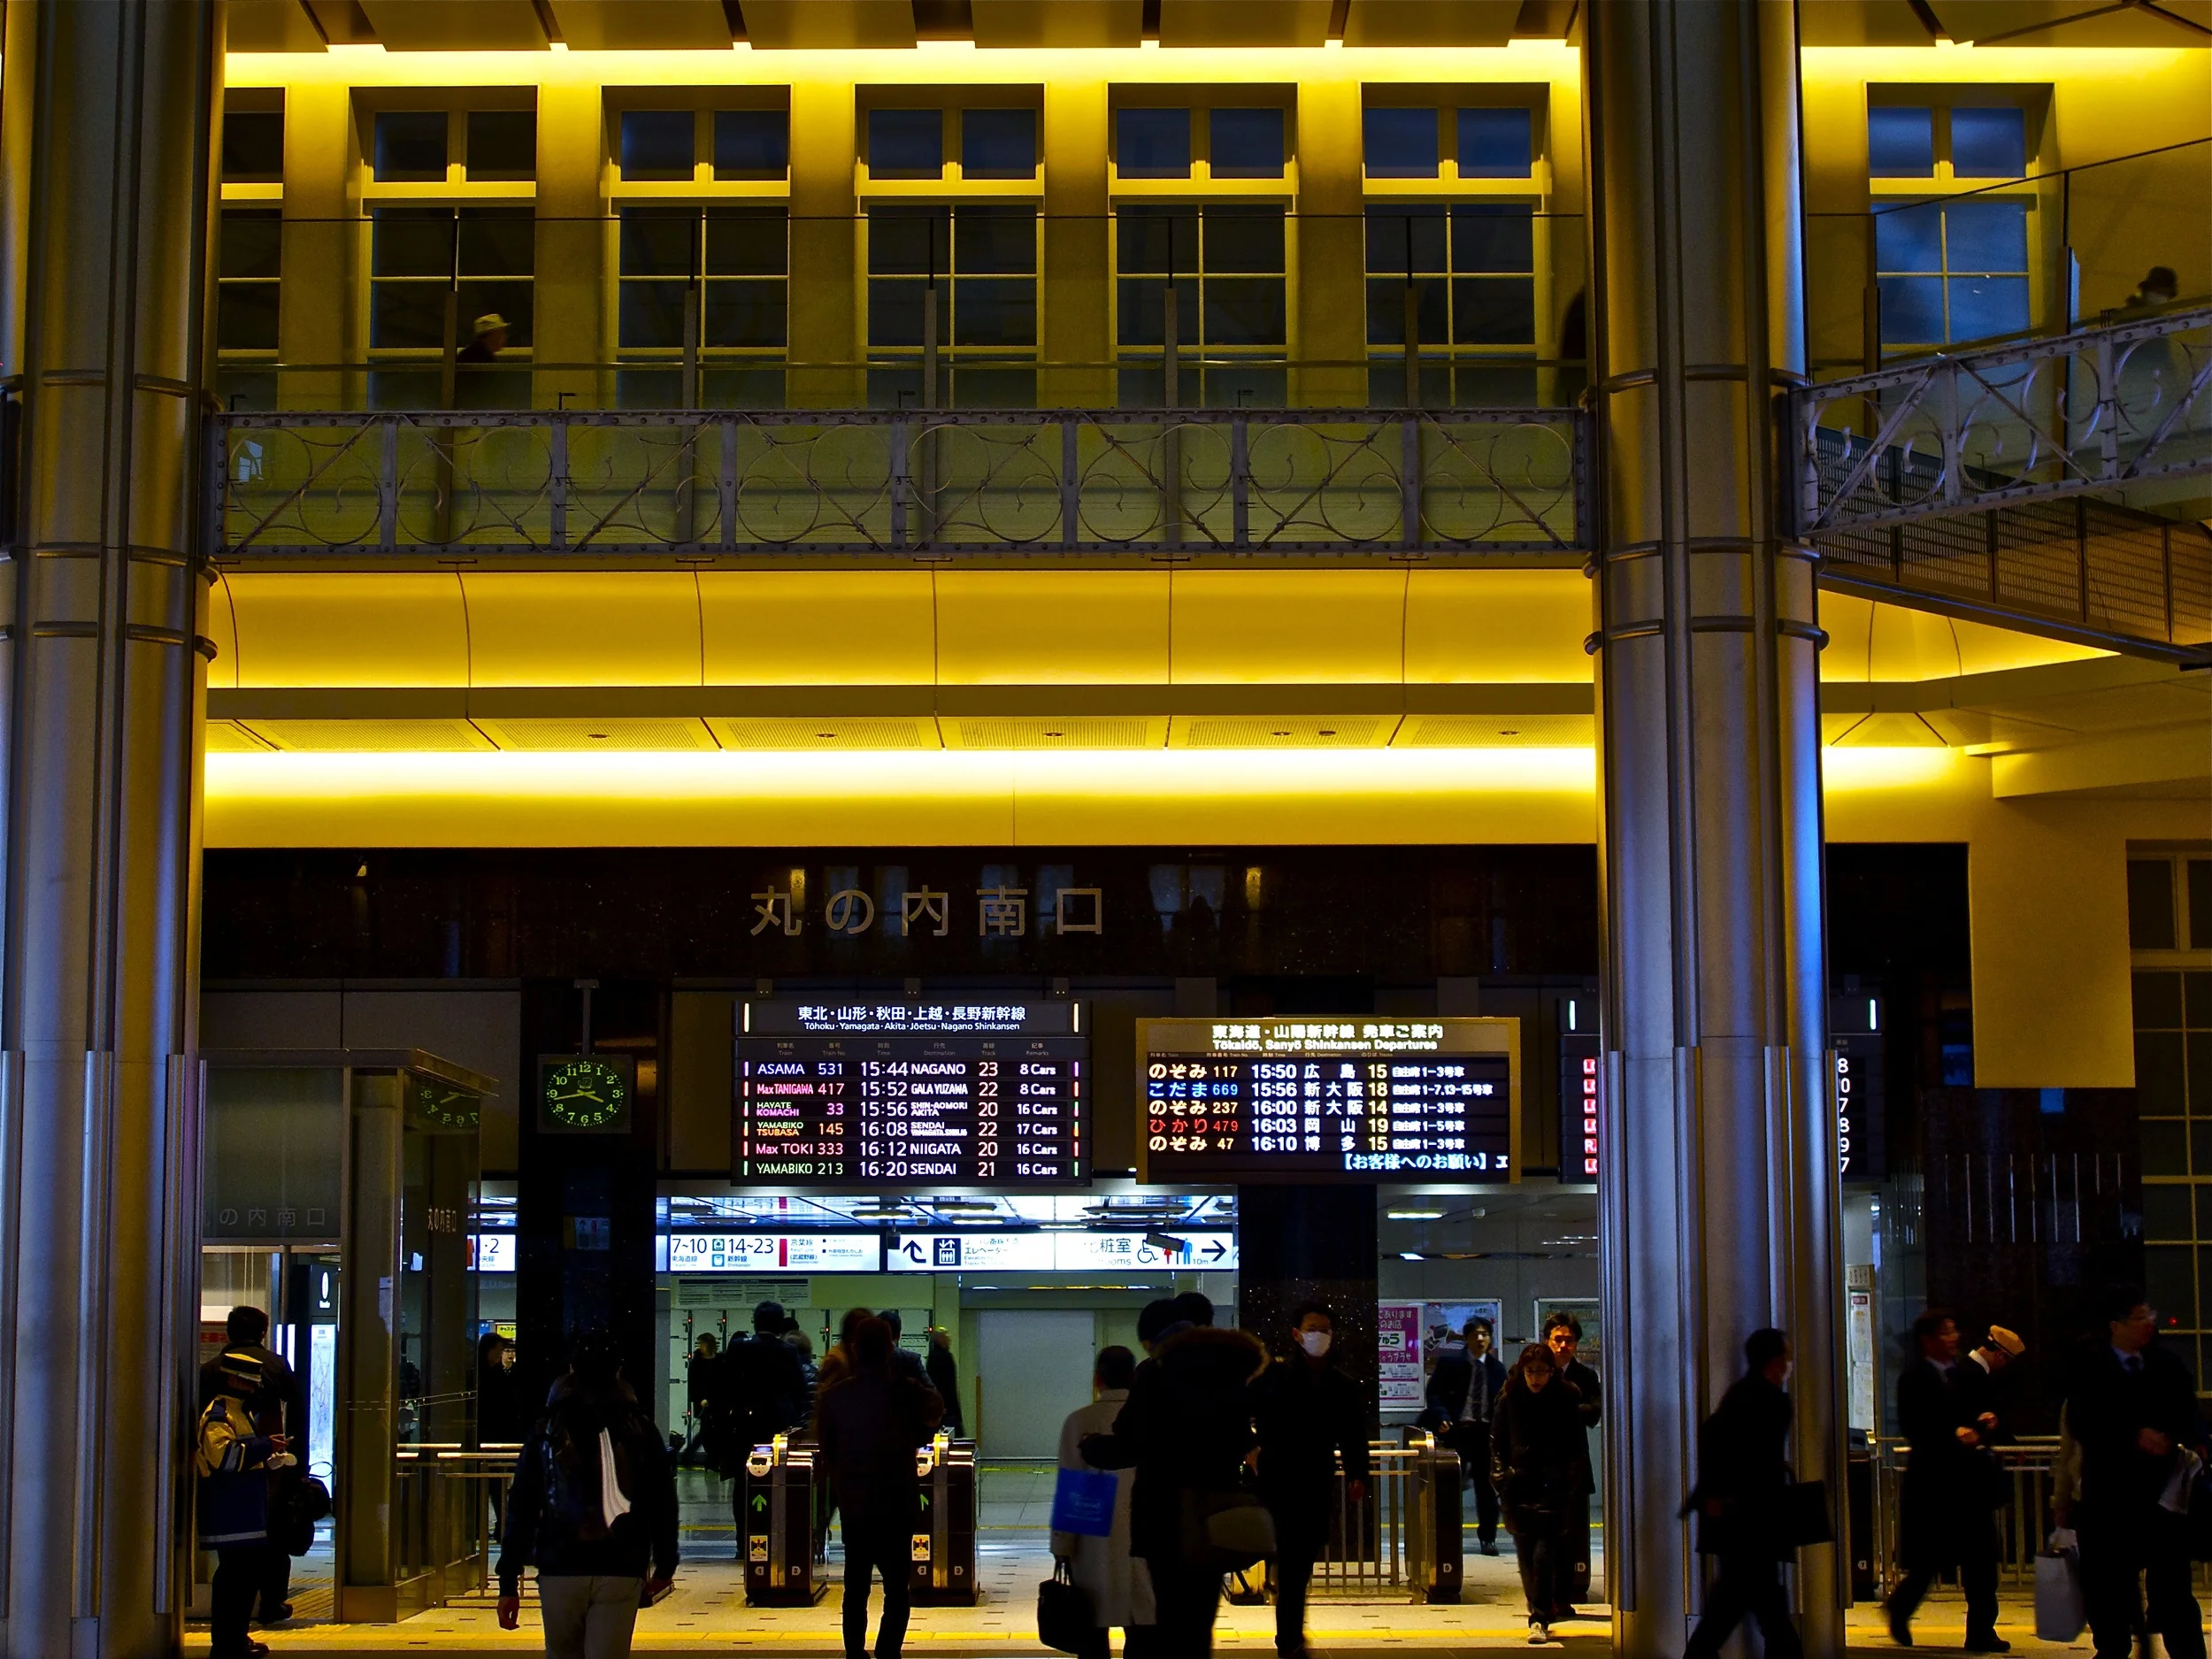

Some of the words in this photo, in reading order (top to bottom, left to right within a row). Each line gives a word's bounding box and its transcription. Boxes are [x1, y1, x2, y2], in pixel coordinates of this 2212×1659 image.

[749, 885, 1103, 937] 丸の内南口
[798, 1006, 1025, 1021] 東北・山形・秋田・上越・長野新幹線
[1212, 1025, 1356, 1039] 東海道・山陽新幹線
[1363, 1025, 1443, 1039] 発車ご案内
[1304, 1040, 1371, 1050] Shinkansen
[1375, 1040, 1437, 1051] Departures
[757, 1064, 805, 1074] ASAMA
[818, 1064, 842, 1075] 531
[861, 1062, 908, 1076] 15:44
[911, 1064, 966, 1075] NAGANO
[979, 1062, 998, 1076] 23
[1019, 1064, 1028, 1075] 8
[1031, 1064, 1056, 1075] Cars
[1149, 1064, 1207, 1079] のぞみ
[1213, 1066, 1238, 1078] 117
[1251, 1064, 1297, 1079] 15:50
[1304, 1064, 1356, 1079] 広島
[1368, 1064, 1387, 1079] 15
[549, 1089, 557, 1098] 9
[818, 1083, 844, 1094] 417
[861, 1081, 908, 1096] 15:52
[979, 1081, 998, 1096] 22
[1019, 1084, 1028, 1094] 8
[1031, 1084, 1056, 1094] Cars
[1149, 1082, 1207, 1097] こだま
[1212, 1084, 1238, 1095] 669
[1251, 1082, 1297, 1097] 15:56
[1304, 1082, 1363, 1097] 新大阪
[1368, 1082, 1387, 1096] 18
[556, 1103, 564, 1112] 8
[606, 1103, 614, 1112] 4
[826, 1103, 844, 1115] 33
[860, 1102, 908, 1117] 15:56
[979, 1102, 998, 1117] 20
[1018, 1103, 1030, 1115] 16
[1033, 1103, 1057, 1115] Cars
[1149, 1100, 1207, 1115] のぞみ
[1212, 1102, 1238, 1114] 237
[1251, 1100, 1297, 1115] 16:00
[1304, 1100, 1363, 1115] 新大阪
[1368, 1101, 1387, 1115] 14
[580, 1115, 588, 1124] 6
[1150, 1118, 1207, 1133] ひかり
[1213, 1121, 1238, 1132] 479
[1251, 1118, 1297, 1133] 16:03
[1304, 1118, 1356, 1133] 岡山
[1368, 1118, 1388, 1133] 19
[818, 1123, 843, 1135] 145
[860, 1122, 908, 1136] 16:08
[979, 1122, 997, 1136] 22
[1018, 1124, 1029, 1134] 17
[1033, 1124, 1057, 1135] Cars
[756, 1143, 778, 1154] Max
[780, 1143, 813, 1154] TOKI
[818, 1143, 843, 1155] 333
[860, 1141, 906, 1156] 16:12
[910, 1143, 962, 1154] NIIGATA
[979, 1141, 998, 1156] 20
[1018, 1144, 1030, 1155] 16
[1033, 1144, 1057, 1155] Cars
[1149, 1136, 1207, 1151] のぞみ
[1217, 1138, 1233, 1149] 47
[1251, 1136, 1297, 1151] 16:10
[1304, 1136, 1356, 1151] 博多
[1368, 1136, 1387, 1150] 15
[757, 1164, 813, 1174] YAMABIKO
[818, 1163, 843, 1174] 213
[860, 1162, 907, 1176] 16:20
[910, 1164, 956, 1174] SENDAI
[979, 1162, 995, 1176] 21
[1018, 1164, 1030, 1174] 16
[1033, 1164, 1057, 1174] Cars
